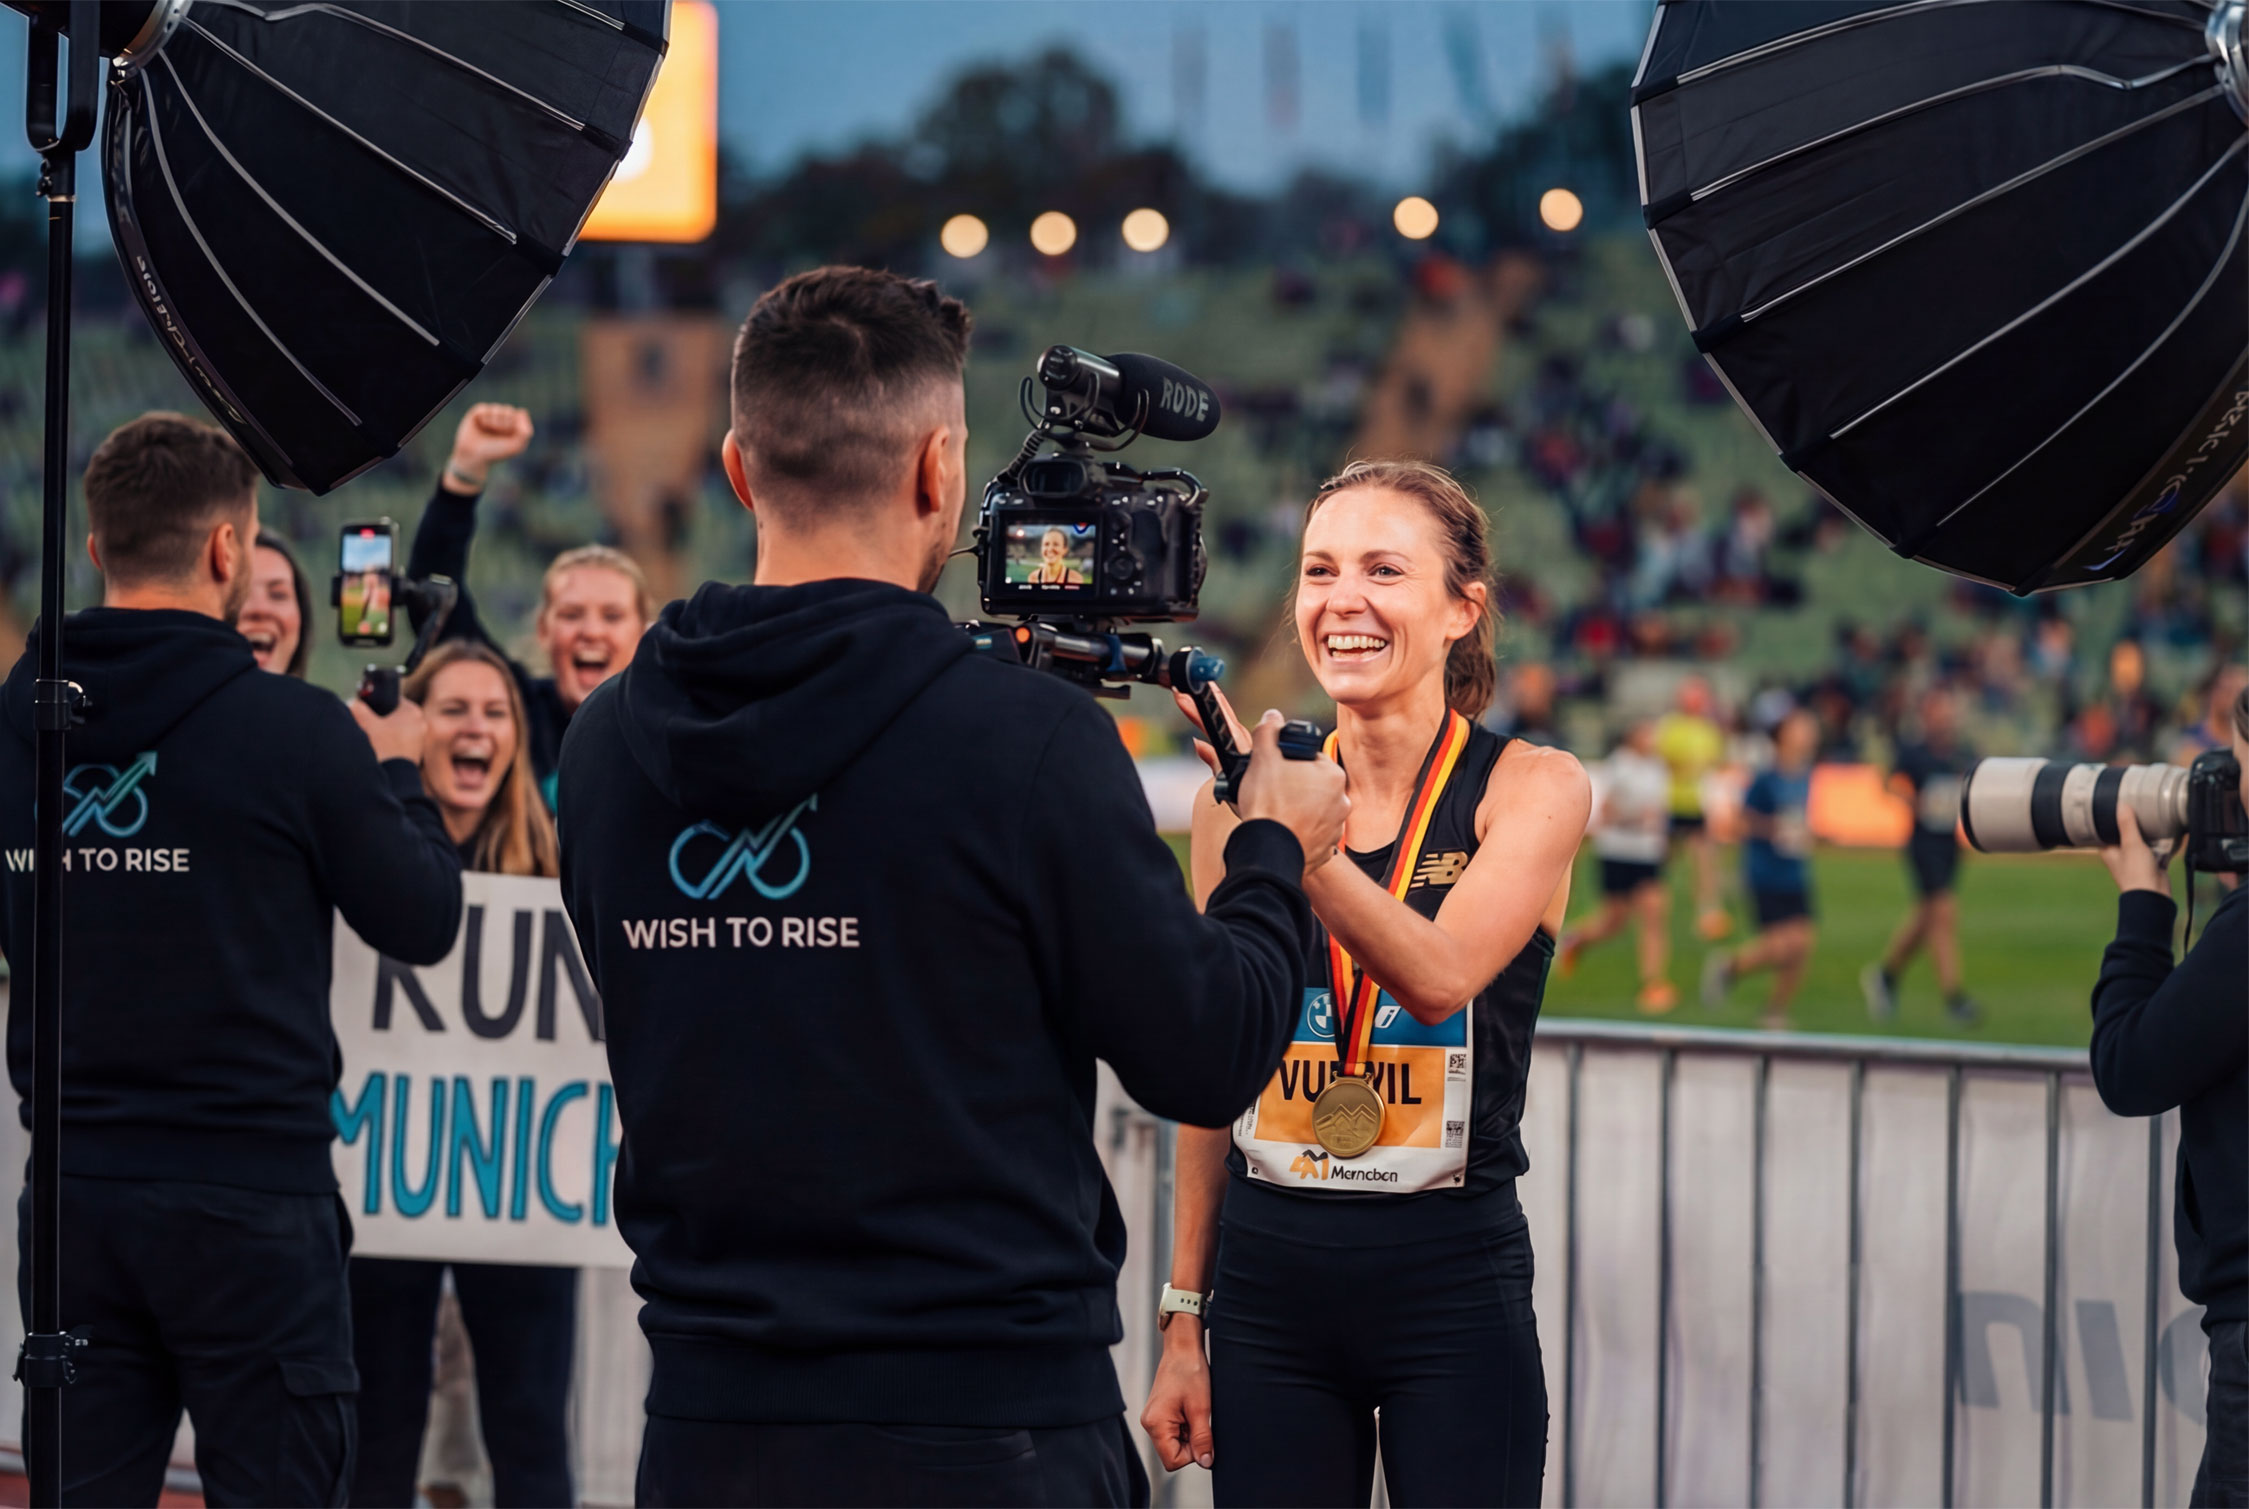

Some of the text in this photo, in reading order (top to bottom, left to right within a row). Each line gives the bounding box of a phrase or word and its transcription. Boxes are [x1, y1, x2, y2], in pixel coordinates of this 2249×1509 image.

[5, 847, 190, 872] WIH TO RISE
[622, 916, 860, 949] WISH TO RISE
